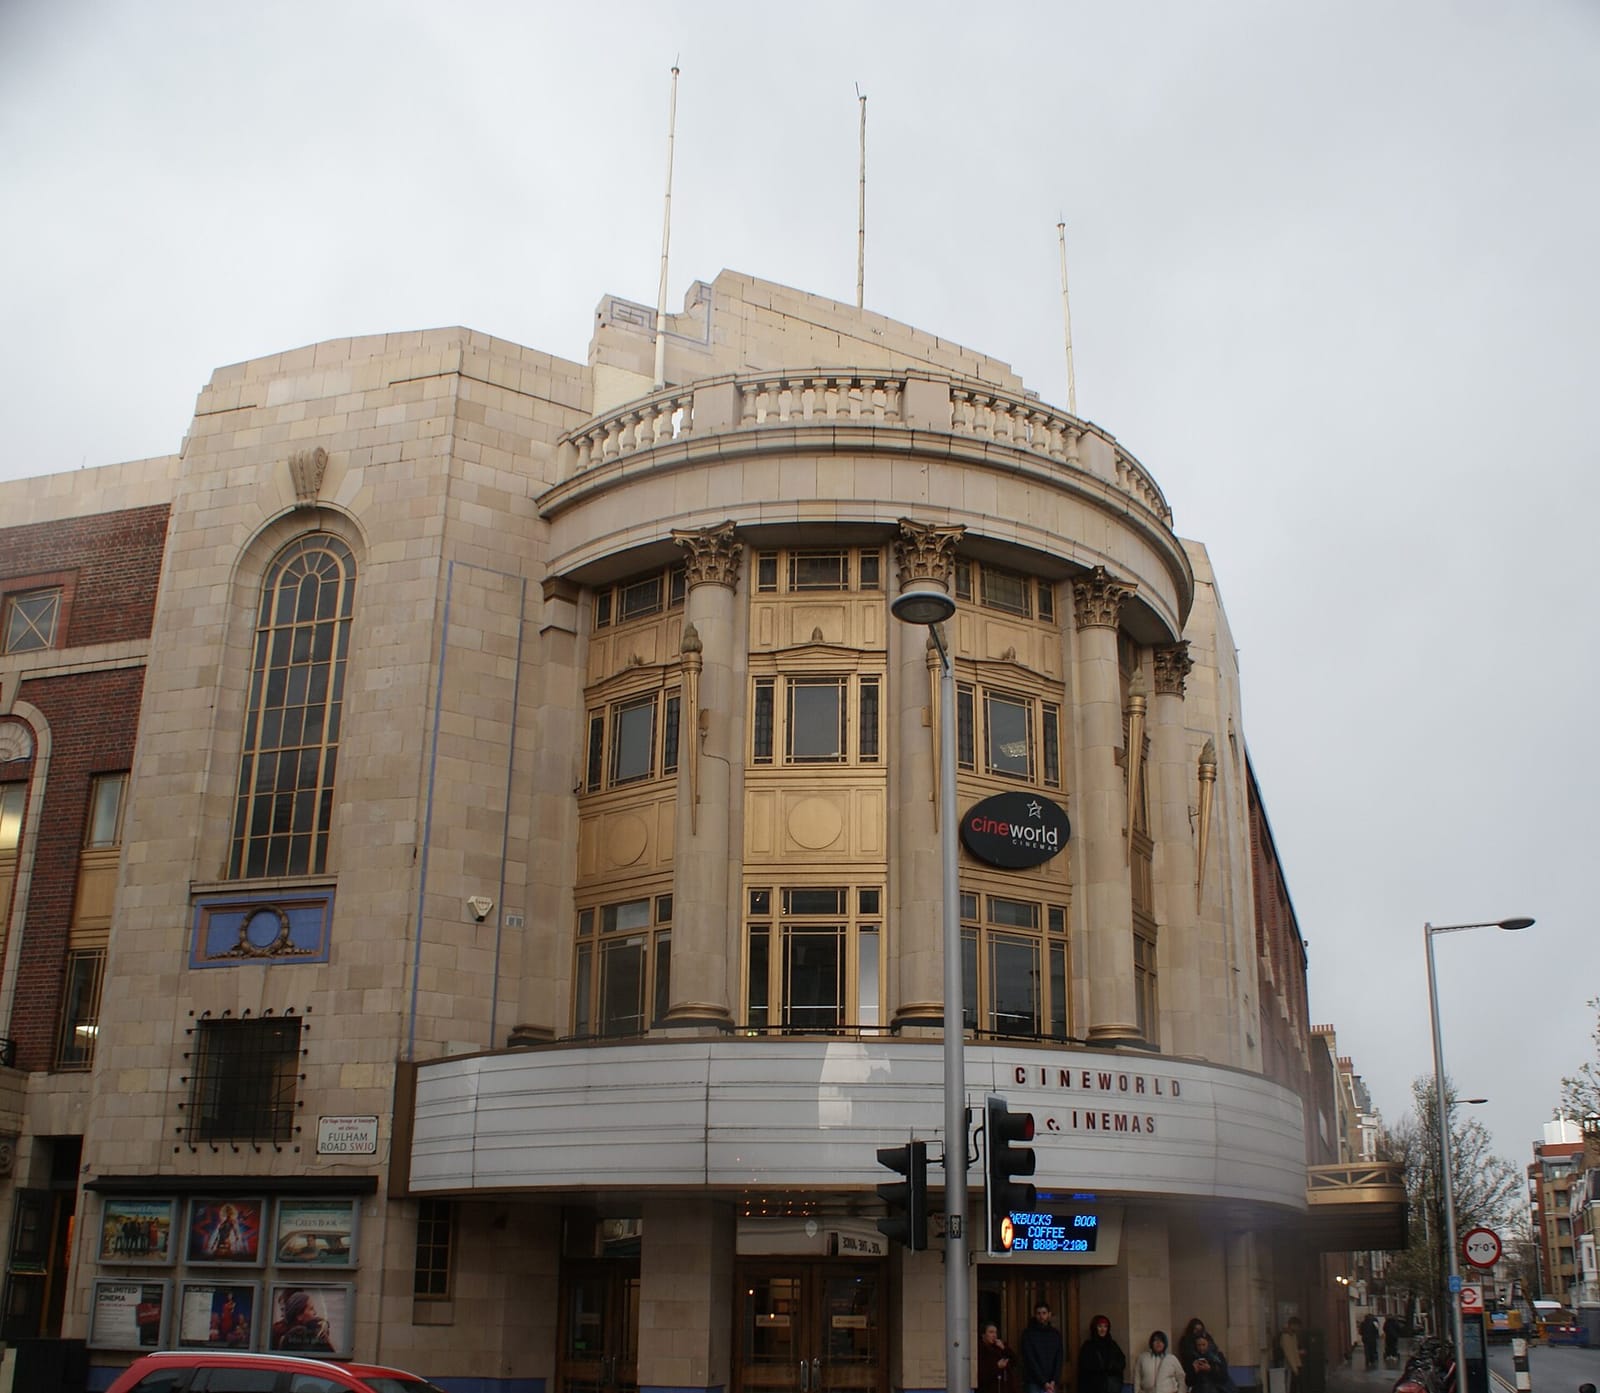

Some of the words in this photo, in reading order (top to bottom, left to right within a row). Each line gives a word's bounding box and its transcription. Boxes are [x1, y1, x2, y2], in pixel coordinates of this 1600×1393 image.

[971, 816, 1058, 845] cineworld
[1012, 839, 1059, 852] CINEMAS
[1015, 1067, 1181, 1097] CINEWORLD
[328, 1132, 368, 1141] FULHAM
[320, 1142, 347, 1151] ROAD
[1028, 1226, 1065, 1239] COFFEE
[1013, 1238, 1028, 1250] EN
